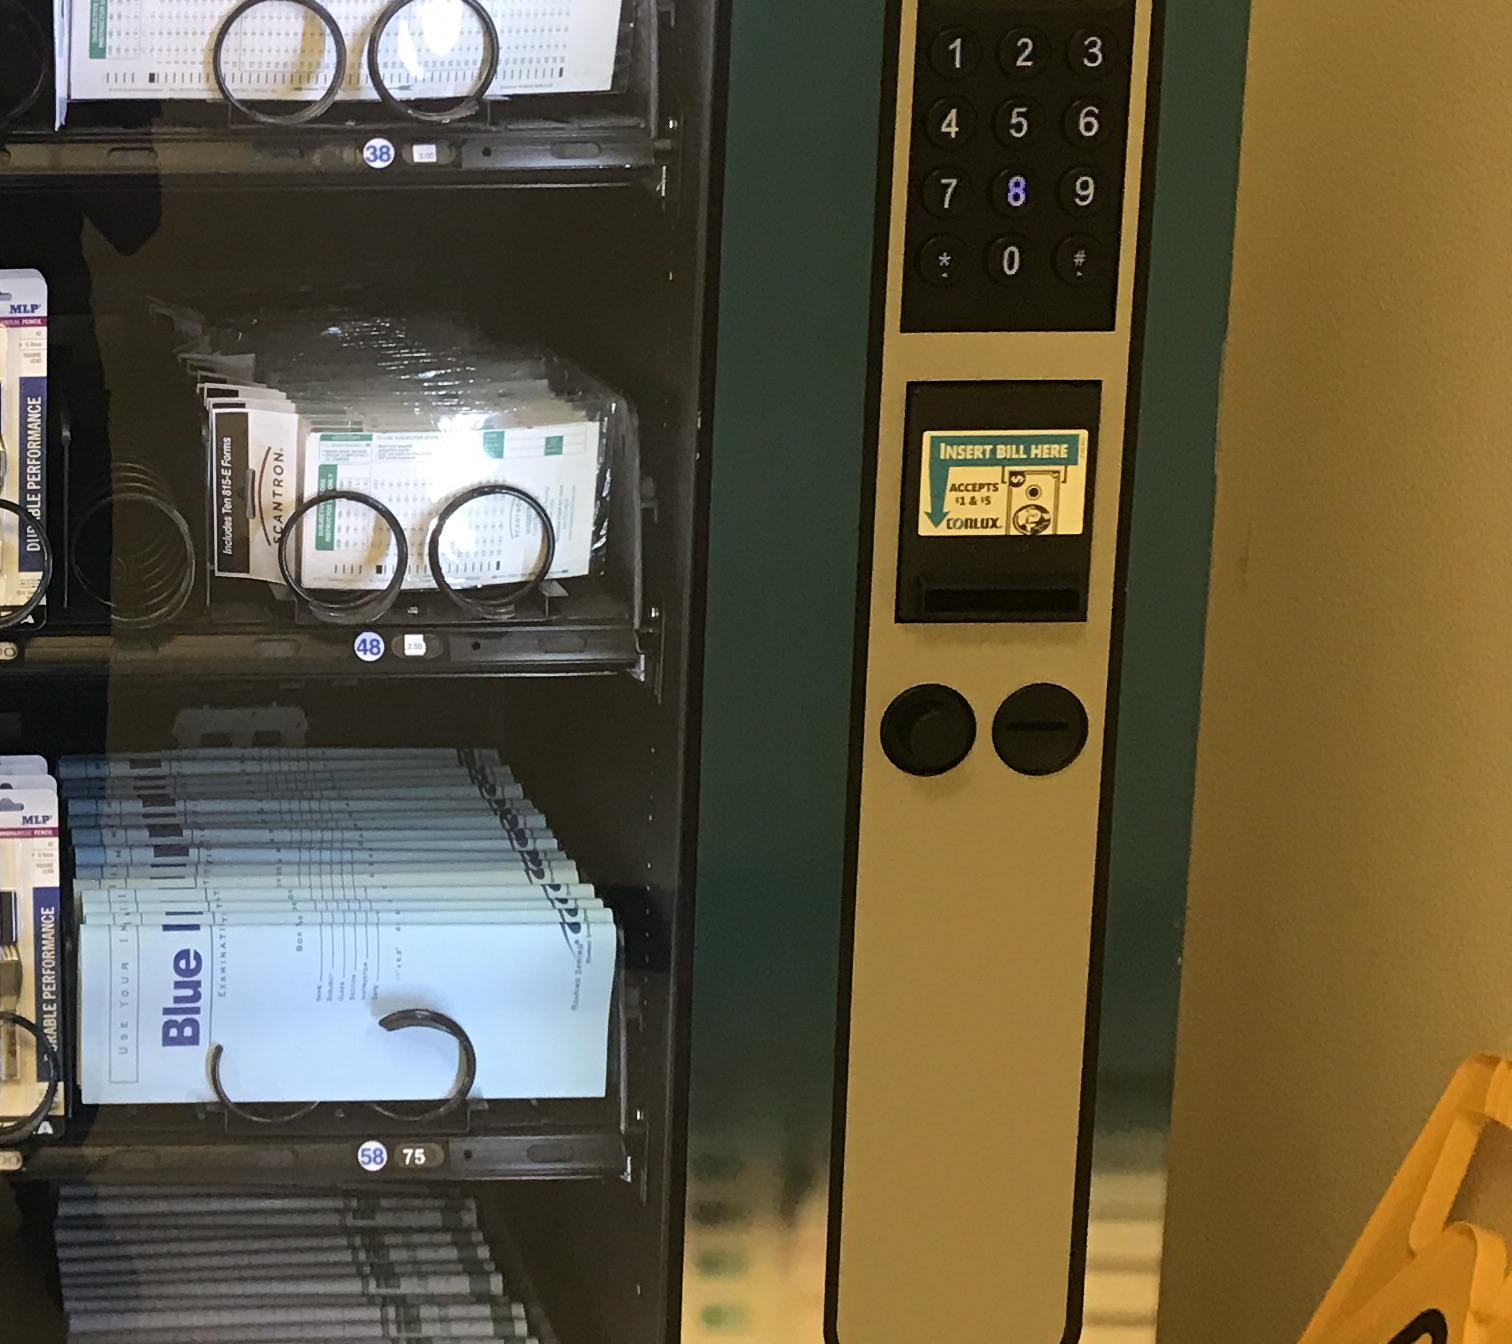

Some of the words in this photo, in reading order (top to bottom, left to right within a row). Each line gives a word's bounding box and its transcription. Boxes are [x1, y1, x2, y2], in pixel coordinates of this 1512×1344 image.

[948, 38, 962, 68] 1
[1016, 38, 1034, 67] 2
[1083, 37, 1103, 67] 3
[941, 109, 959, 138] 4
[1009, 108, 1028, 137] 5
[1079, 107, 1099, 136] 6
[366, 145, 390, 163] 38
[940, 179, 958, 208] 7
[1008, 176, 1027, 206] 8
[1074, 177, 1095, 206] 9
[1003, 246, 1020, 275] 0
[10, 304, 39, 314] MLP
[28, 397, 41, 489] PERFORMANCE
[223, 436, 231, 457] Forms
[940, 443, 993, 459] INSERT
[996, 445, 1027, 459] BILL
[1031, 444, 1068, 458] HERE
[222, 459, 232, 498] 815-E
[950, 483, 999, 493] ACCEPTS
[222, 499, 232, 514] Ten
[273, 452, 284, 544] SCANTRON
[955, 496, 965, 506] $1
[969, 496, 977, 505] &
[981, 496, 991, 505] $5
[222, 516, 232, 554] Includes
[356, 639, 381, 655] 48
[43, 906, 55, 1007] PERFORMANCE
[161, 947, 202, 1047] Blue
[360, 1149, 384, 1164] 58
[402, 1149, 425, 1164] 75
